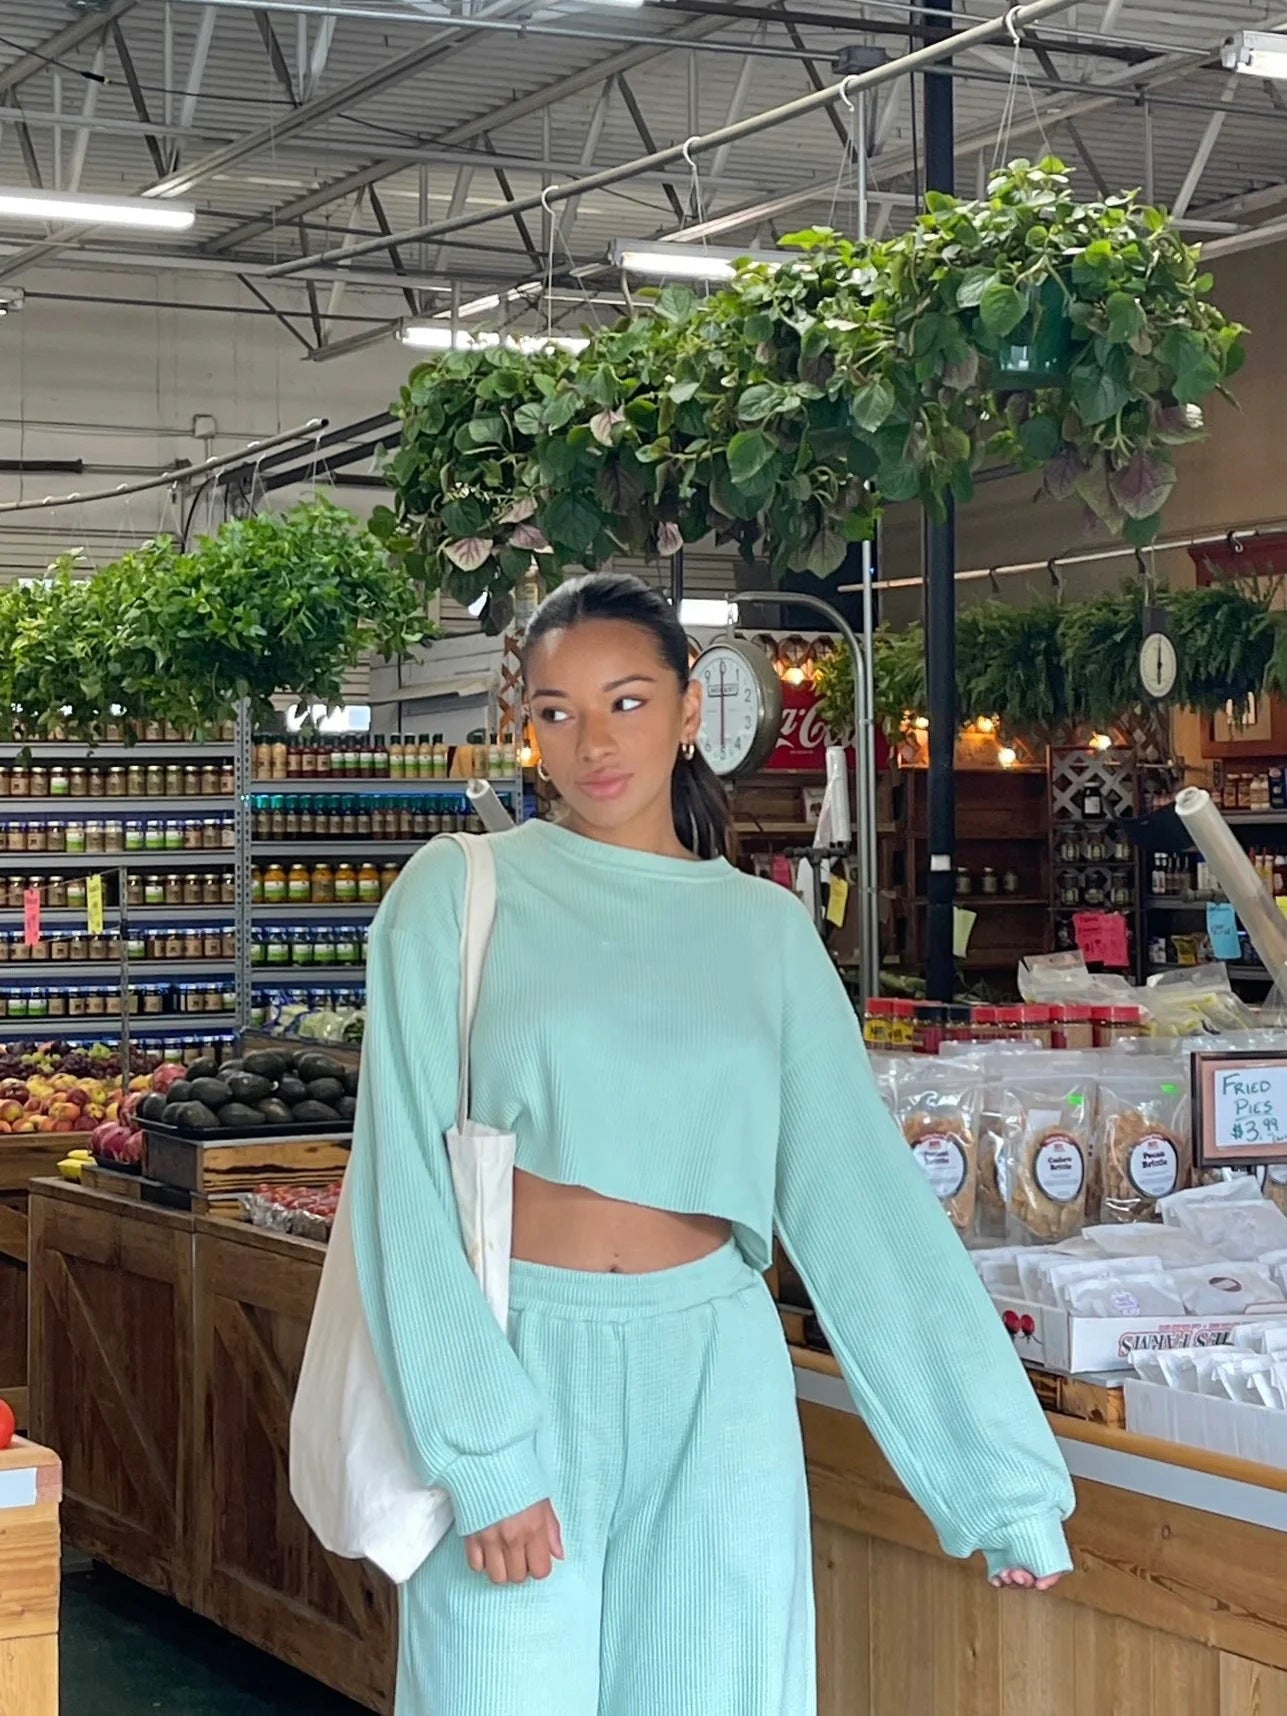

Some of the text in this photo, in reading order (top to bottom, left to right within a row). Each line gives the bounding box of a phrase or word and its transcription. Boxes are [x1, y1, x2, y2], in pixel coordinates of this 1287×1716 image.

[744, 688, 752, 702] 2
[744, 715, 752, 729] 3
[1222, 1073, 1271, 1095] FRIED
[1235, 1098, 1272, 1116] PIES
